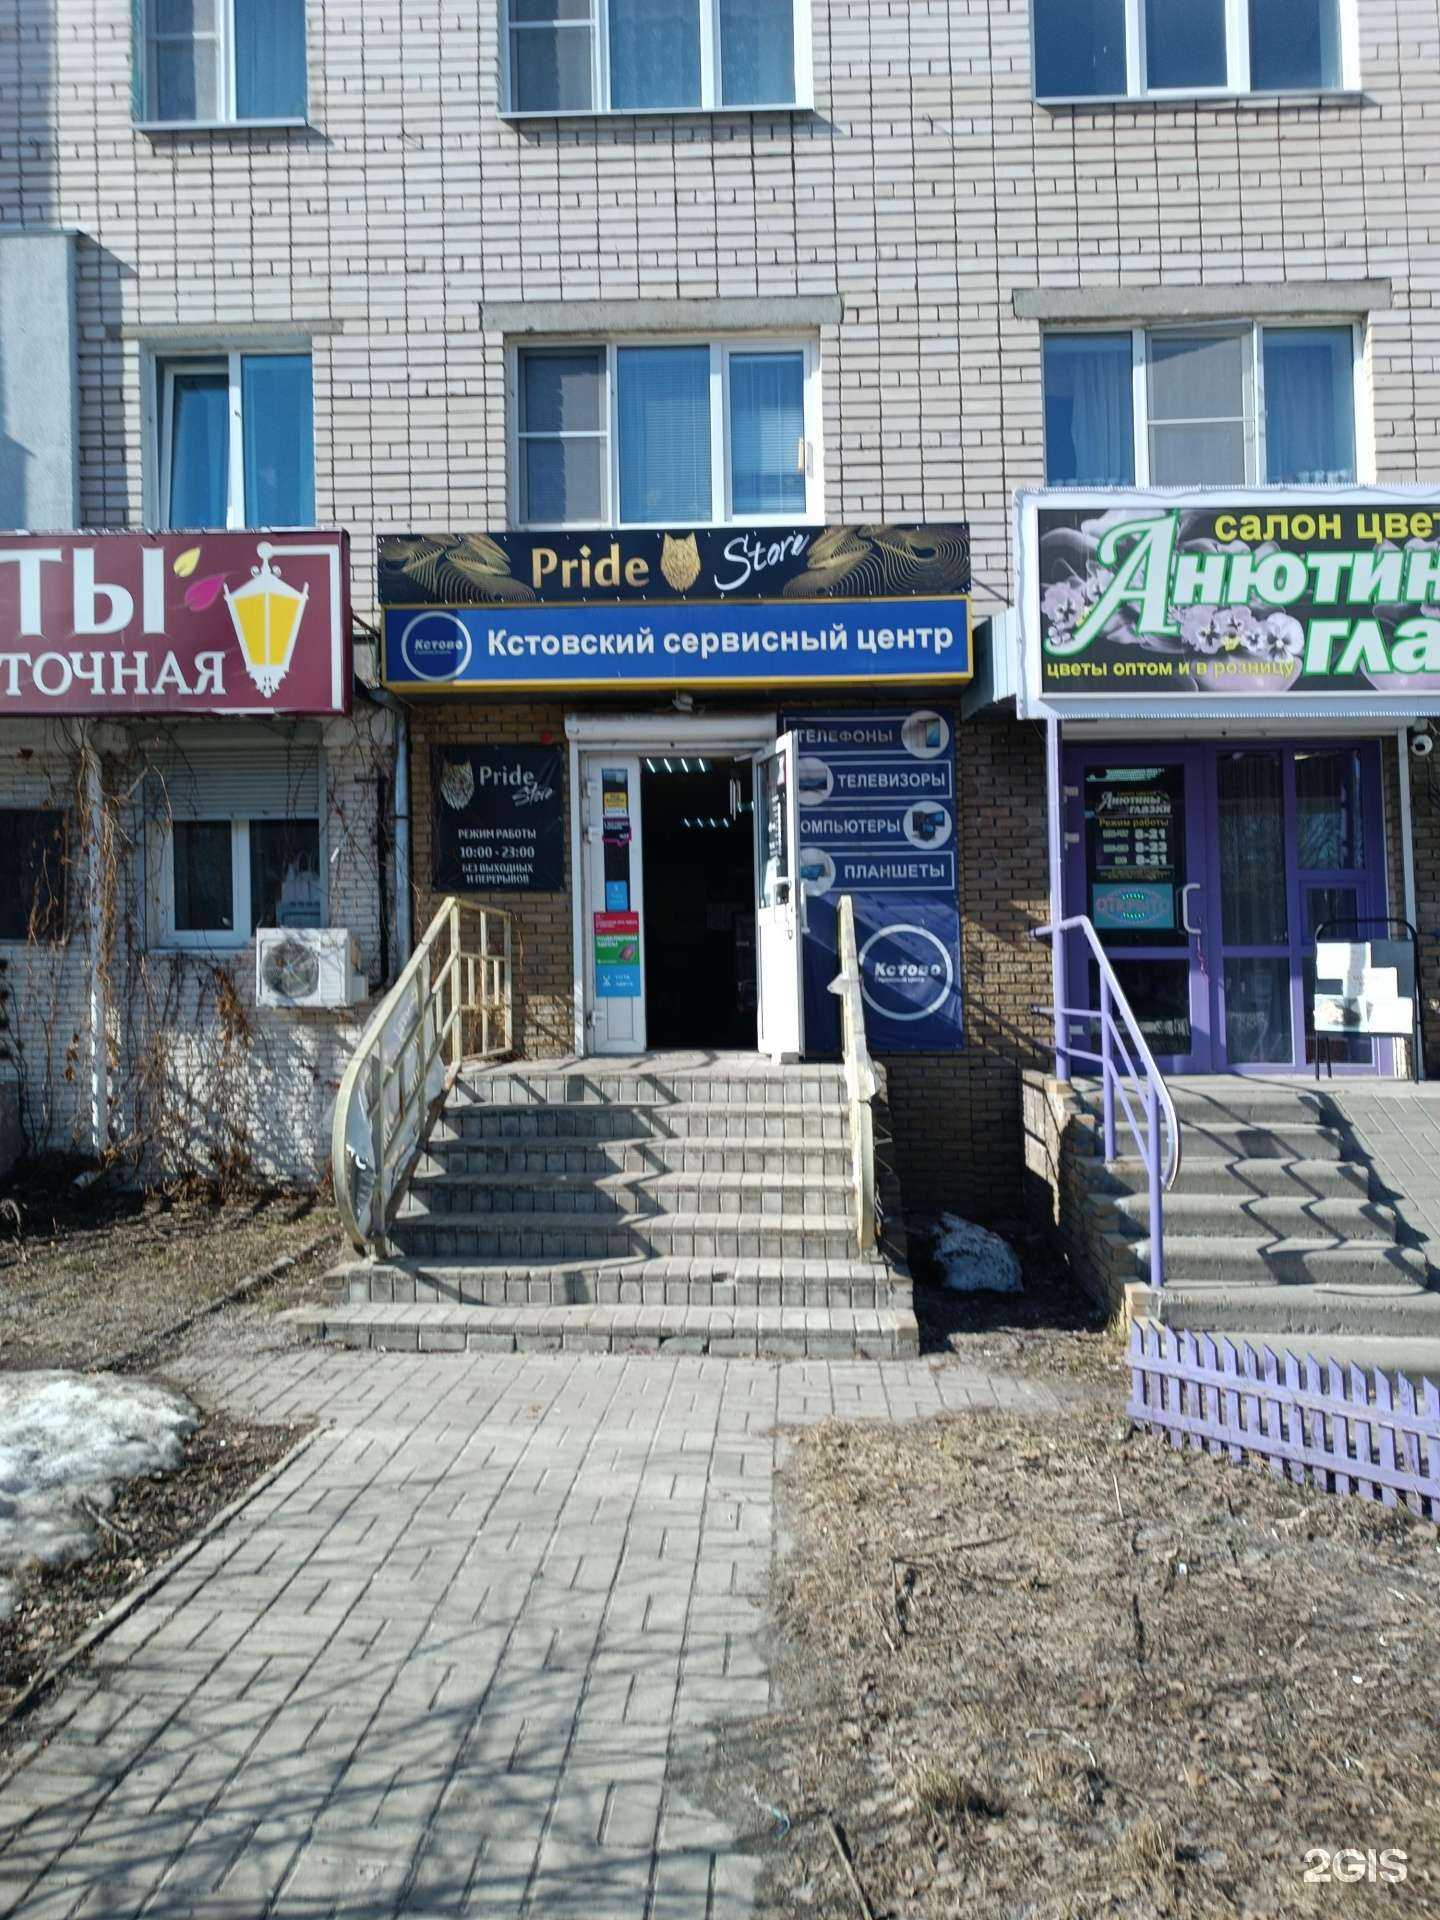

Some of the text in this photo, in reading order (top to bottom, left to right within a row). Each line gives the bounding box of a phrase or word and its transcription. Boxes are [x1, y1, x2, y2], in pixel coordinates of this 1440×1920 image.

[1214, 512, 1342, 541] салон
[531, 533, 811, 591] Pride Store
[488, 624, 953, 659] Кстовский сервисный центр
[1303, 616, 1440, 676] гла
[0, 651, 227, 696] ТОЧНАЯ
[1046, 659, 1295, 679] цветы оптом и в розницу
[479, 764, 535, 786] Pride
[837, 773, 946, 788] ТЕЛЕВИЗОРЫ
[458, 829, 536, 839] РЕЖИМ РАБОТЫ
[800, 819, 900, 834] ОМПЬЮТЕРЫ
[460, 846, 493, 858] 10:00
[844, 863, 945, 879] ПЛАНШЕТЫ
[874, 962, 942, 977] Кстово
